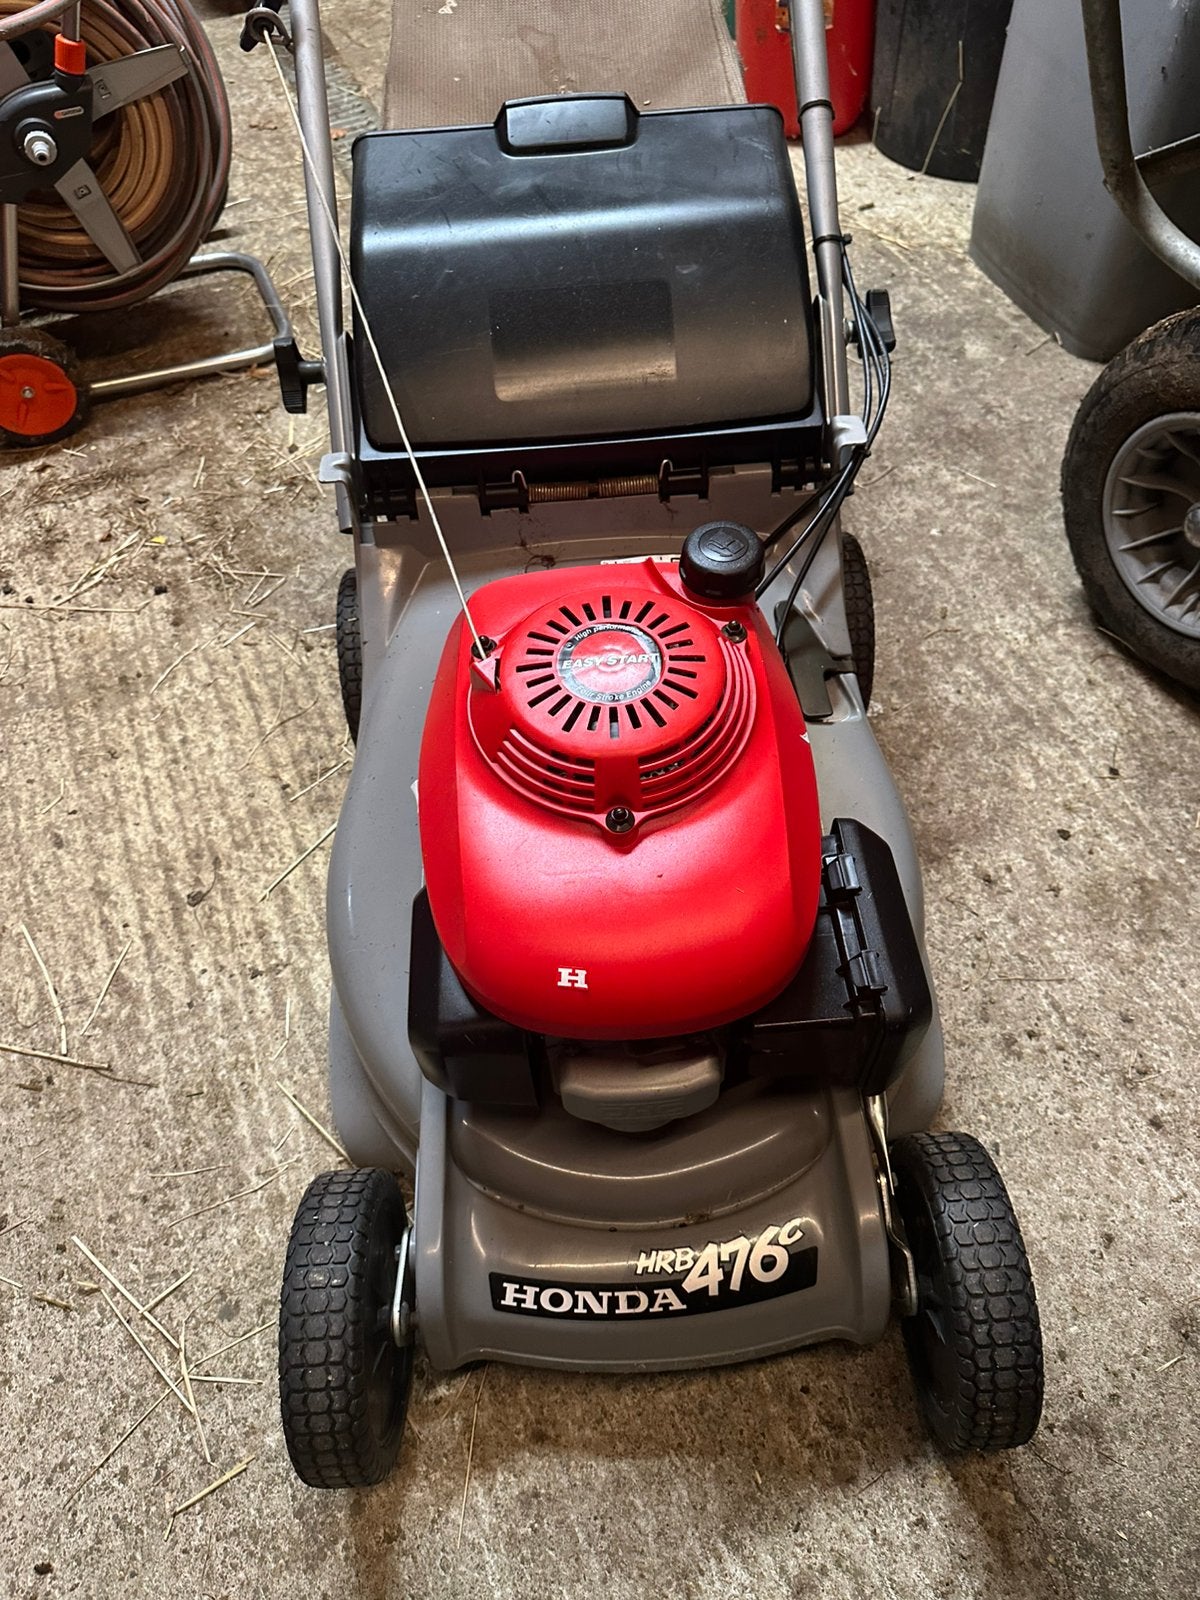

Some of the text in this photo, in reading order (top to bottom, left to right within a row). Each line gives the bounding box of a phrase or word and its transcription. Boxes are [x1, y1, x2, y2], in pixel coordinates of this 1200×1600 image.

[575, 623, 644, 641] High performan
[561, 652, 660, 670] EASY START
[595, 692, 625, 701] Stroke
[626, 680, 653, 698] Engine
[557, 967, 588, 989] H
[501, 1282, 687, 1316] HONDA
